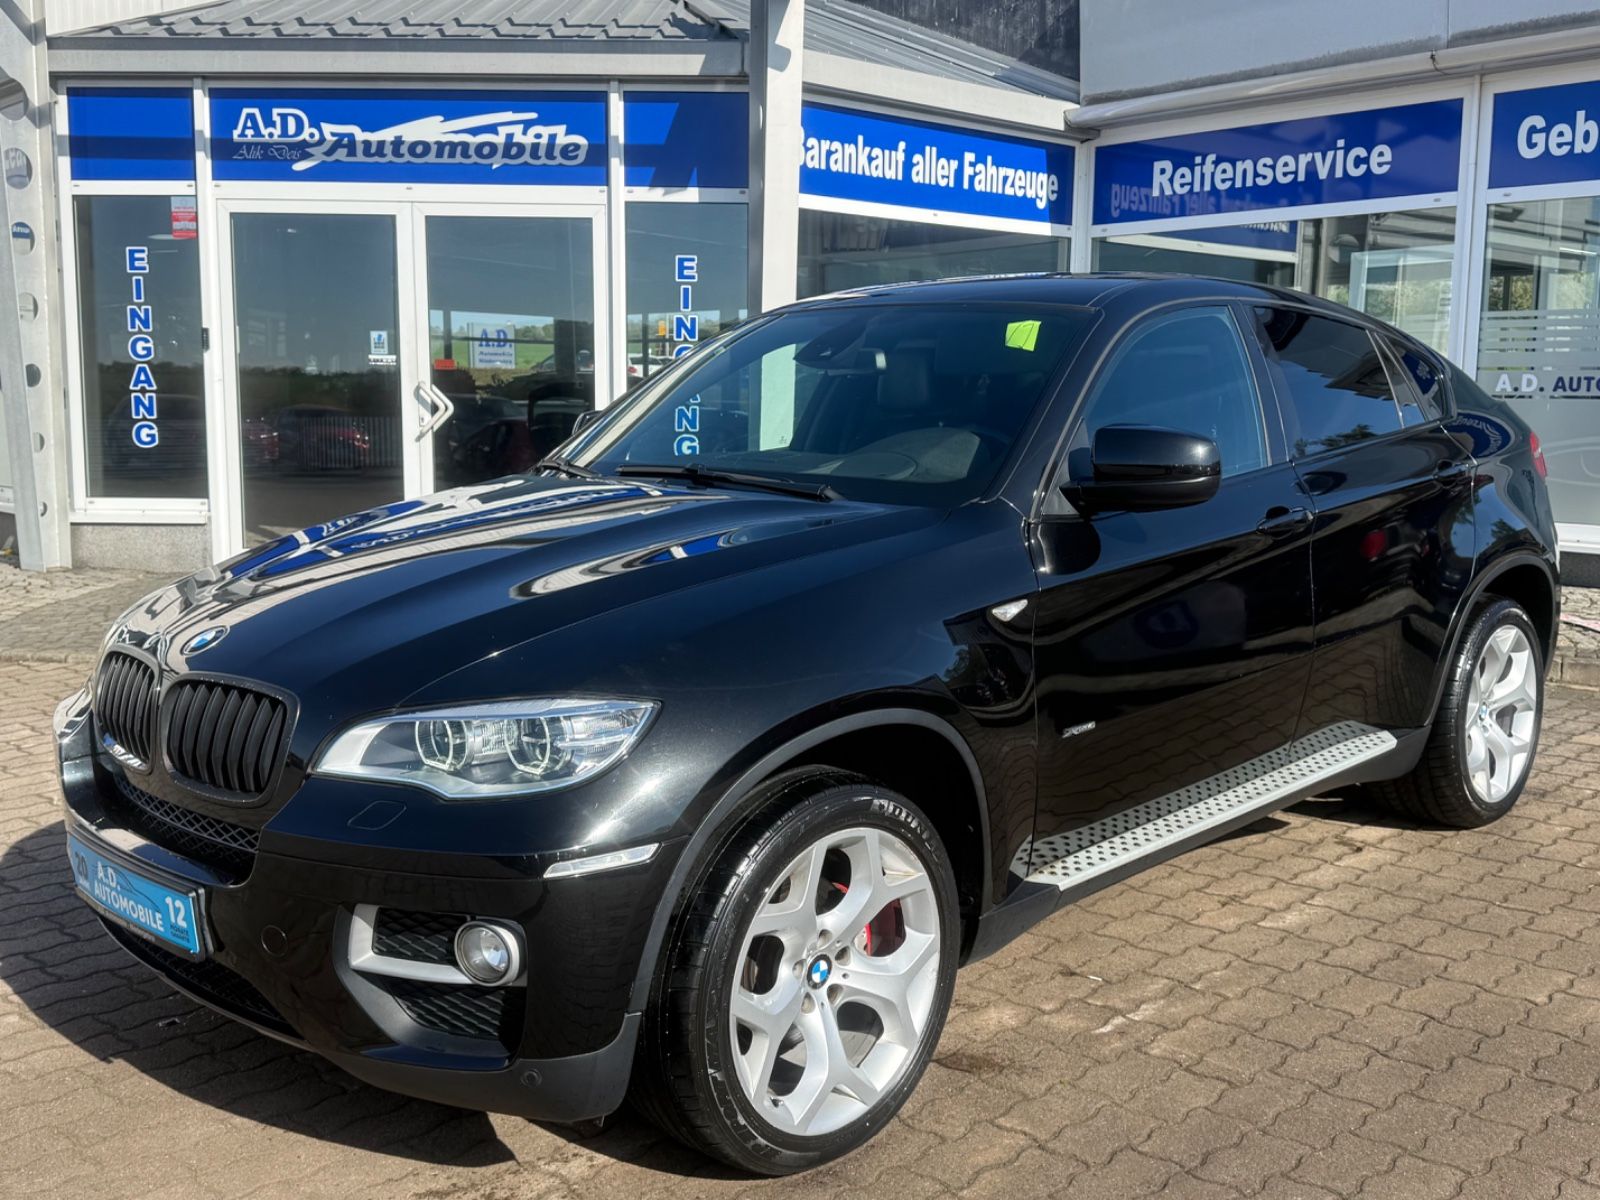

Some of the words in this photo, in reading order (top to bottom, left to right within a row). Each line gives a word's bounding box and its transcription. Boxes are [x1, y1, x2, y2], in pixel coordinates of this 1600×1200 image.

[233, 108, 320, 143] A.D.
[319, 126, 587, 166] Automobile
[1517, 110, 1599, 159] Geb
[911, 145, 958, 188] aller
[963, 151, 1058, 210] Fahrzeuge
[1152, 138, 1392, 197] Reifenservice
[126, 246, 159, 448] EINGANG
[1495, 373, 1544, 393] A.D.
[97, 861, 121, 891] A.D.
[94, 880, 165, 931] AUTOMOBILE
[165, 896, 187, 928] 12
